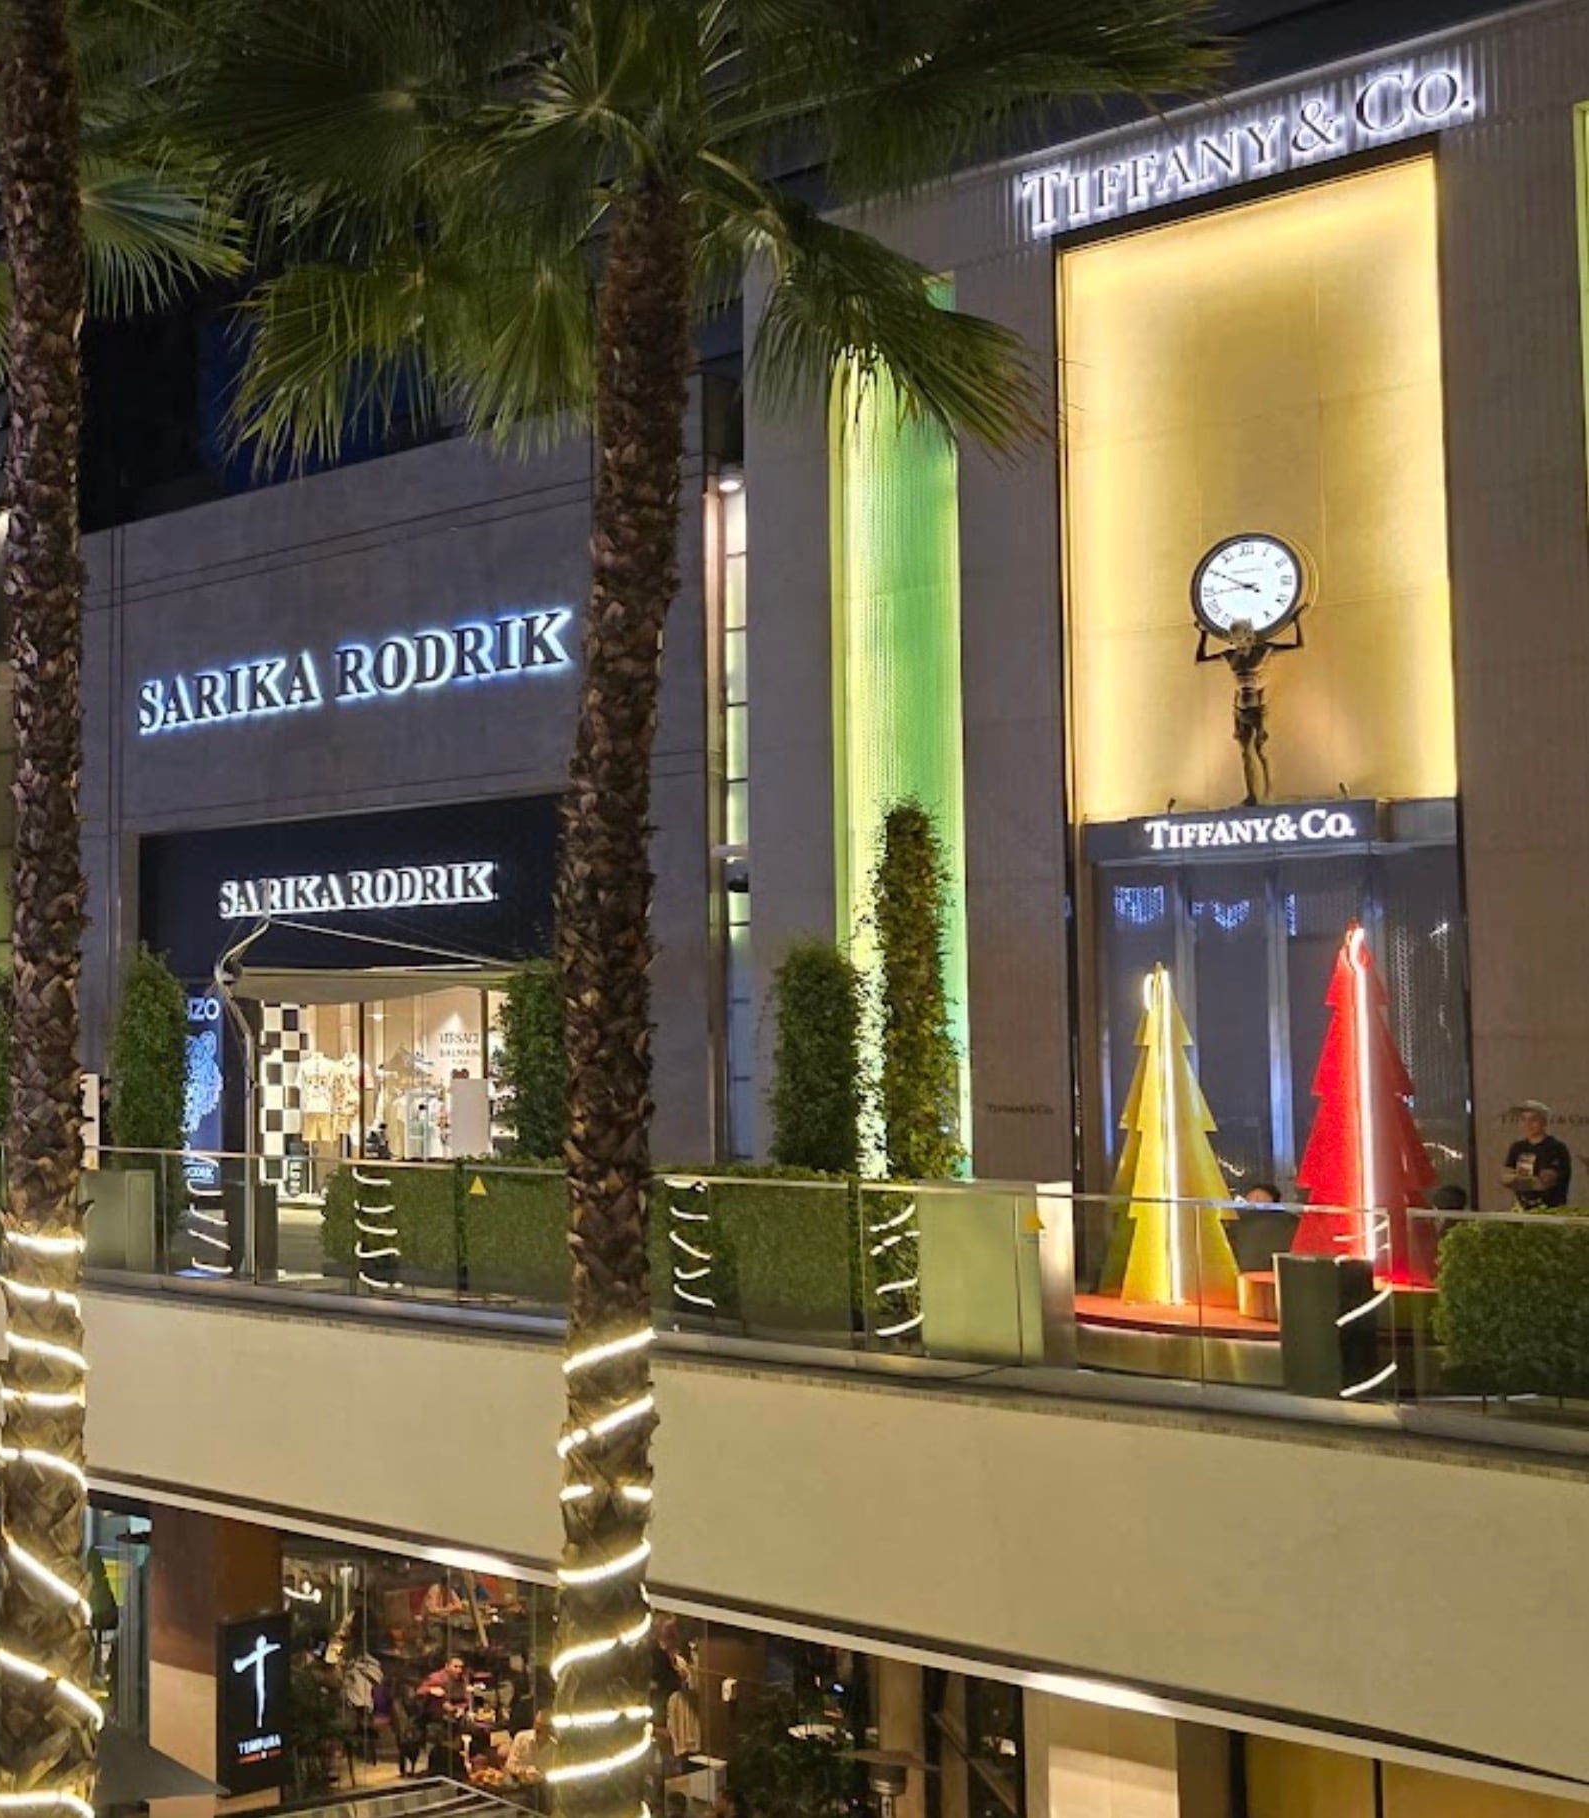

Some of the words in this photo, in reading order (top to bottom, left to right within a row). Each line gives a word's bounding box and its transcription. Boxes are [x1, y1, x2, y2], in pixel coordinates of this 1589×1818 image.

[138, 650, 321, 735] SARIKA
[334, 608, 573, 700] RODRIK
[219, 870, 346, 918] SARIKA
[347, 861, 494, 911] RODRIK
